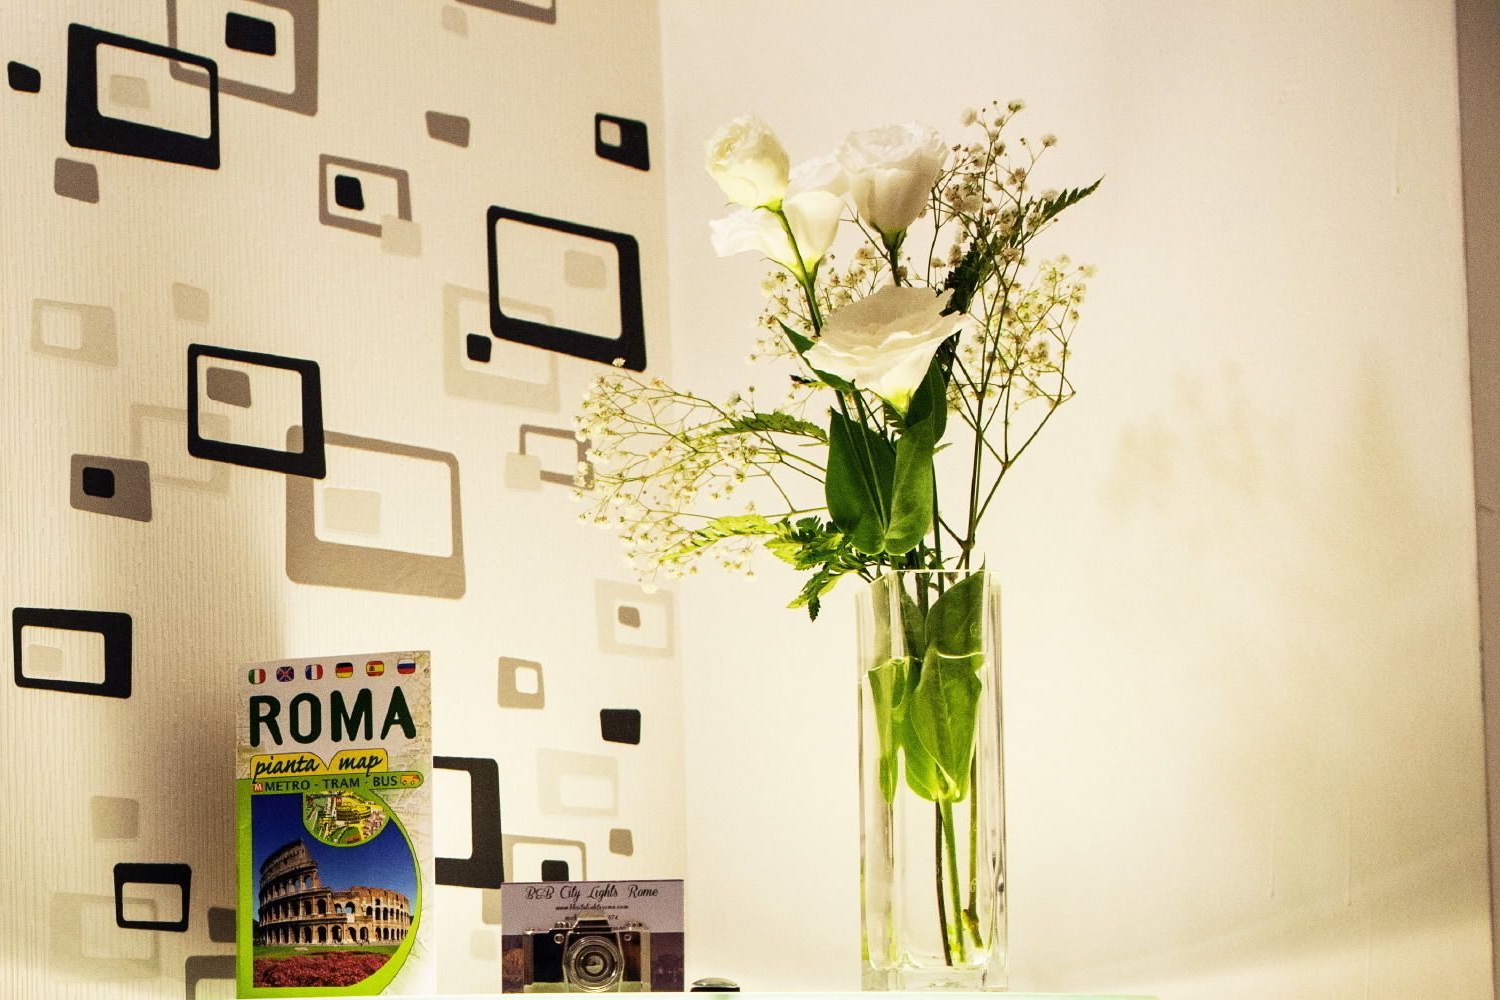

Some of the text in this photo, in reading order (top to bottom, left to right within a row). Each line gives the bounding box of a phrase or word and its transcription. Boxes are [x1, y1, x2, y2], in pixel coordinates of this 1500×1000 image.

[250, 686, 417, 747] ROMA
[252, 755, 383, 784] pianta map
[265, 780, 310, 792] METRO
[322, 778, 360, 789] TRAM
[373, 775, 398, 787] BUS
[526, 884, 659, 902] B&B City Lights Rome
